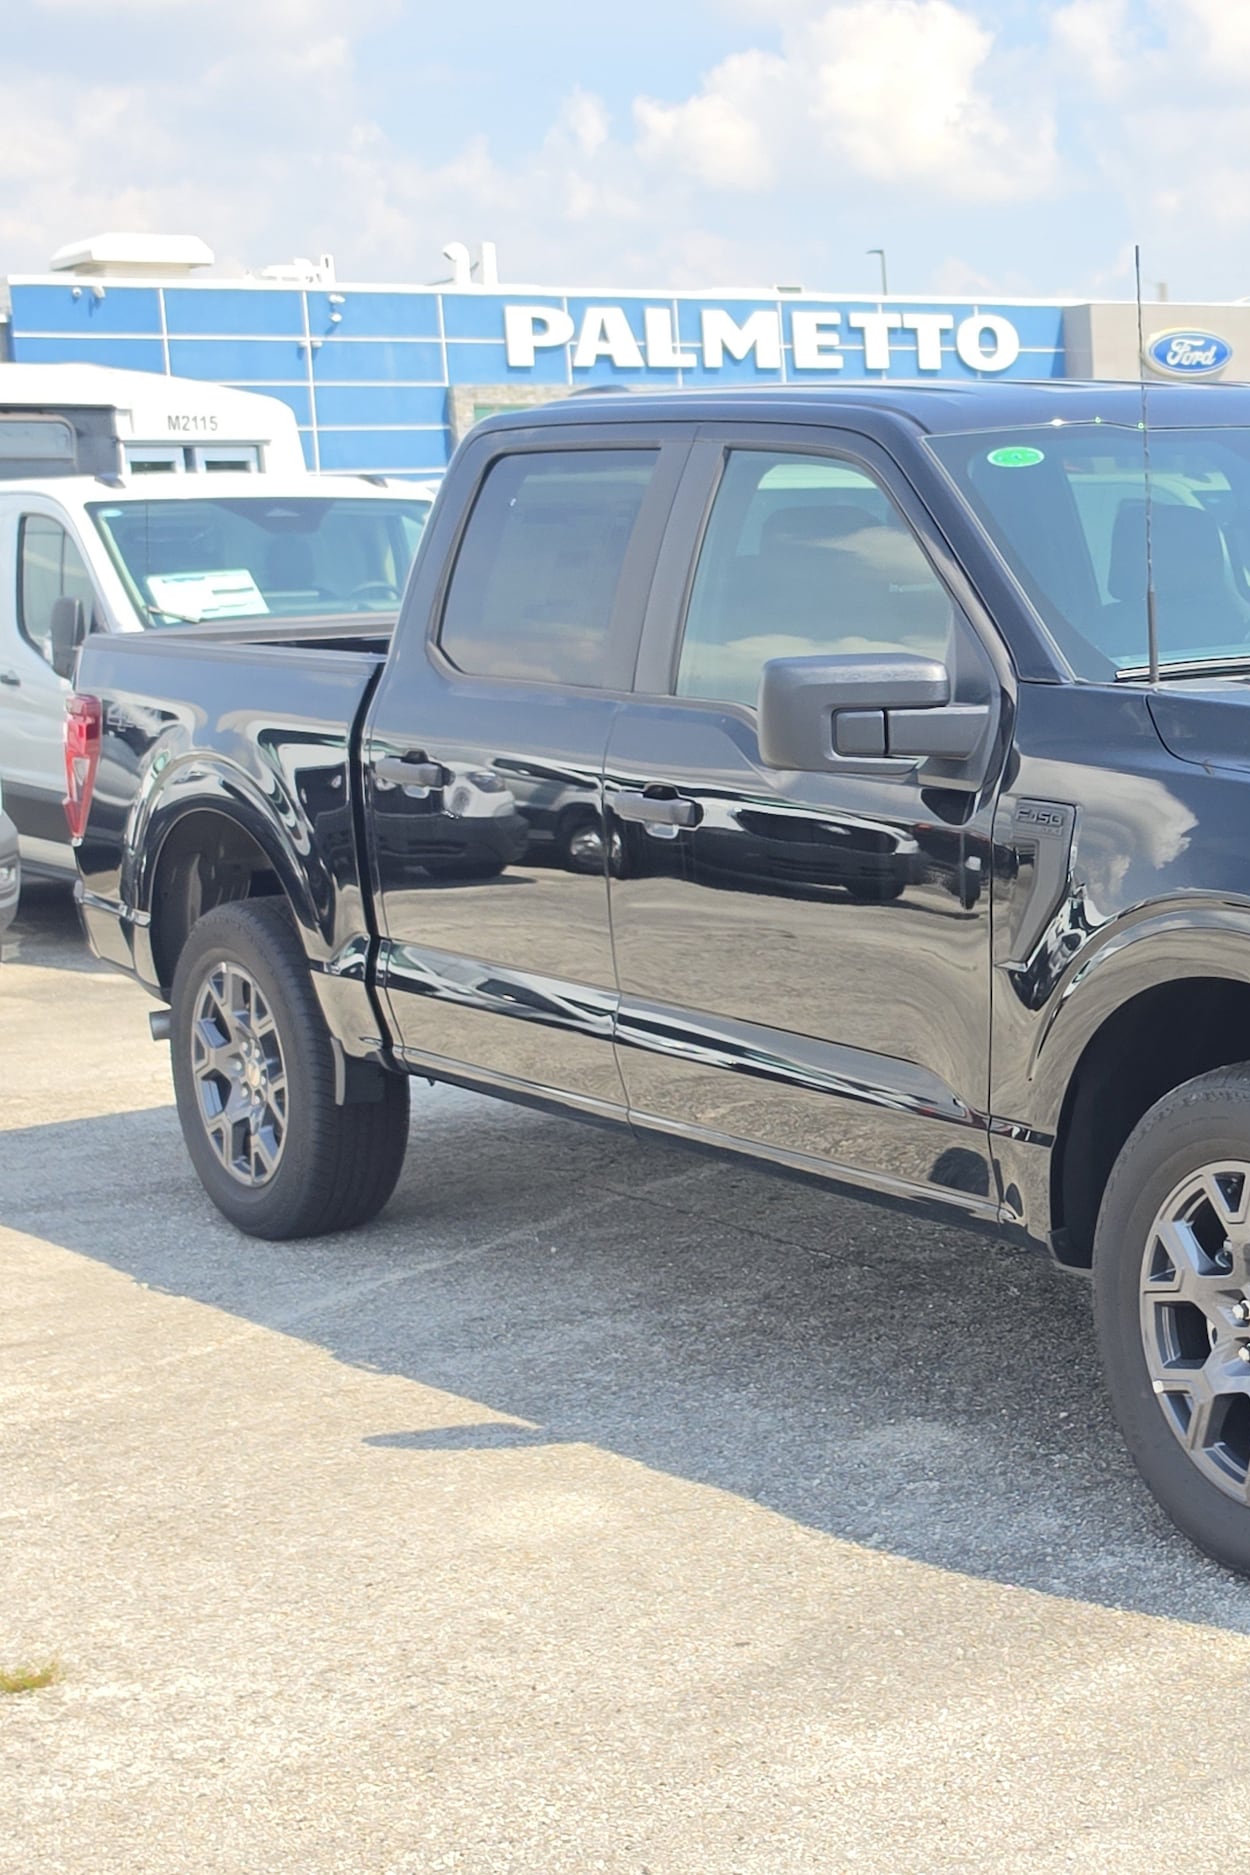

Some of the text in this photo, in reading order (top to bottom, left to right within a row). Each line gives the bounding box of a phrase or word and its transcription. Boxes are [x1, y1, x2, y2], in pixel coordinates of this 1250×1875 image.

[503, 305, 1020, 372] PALMETTO
[1166, 339, 1217, 366] Ford
[167, 415, 218, 432] M2115
